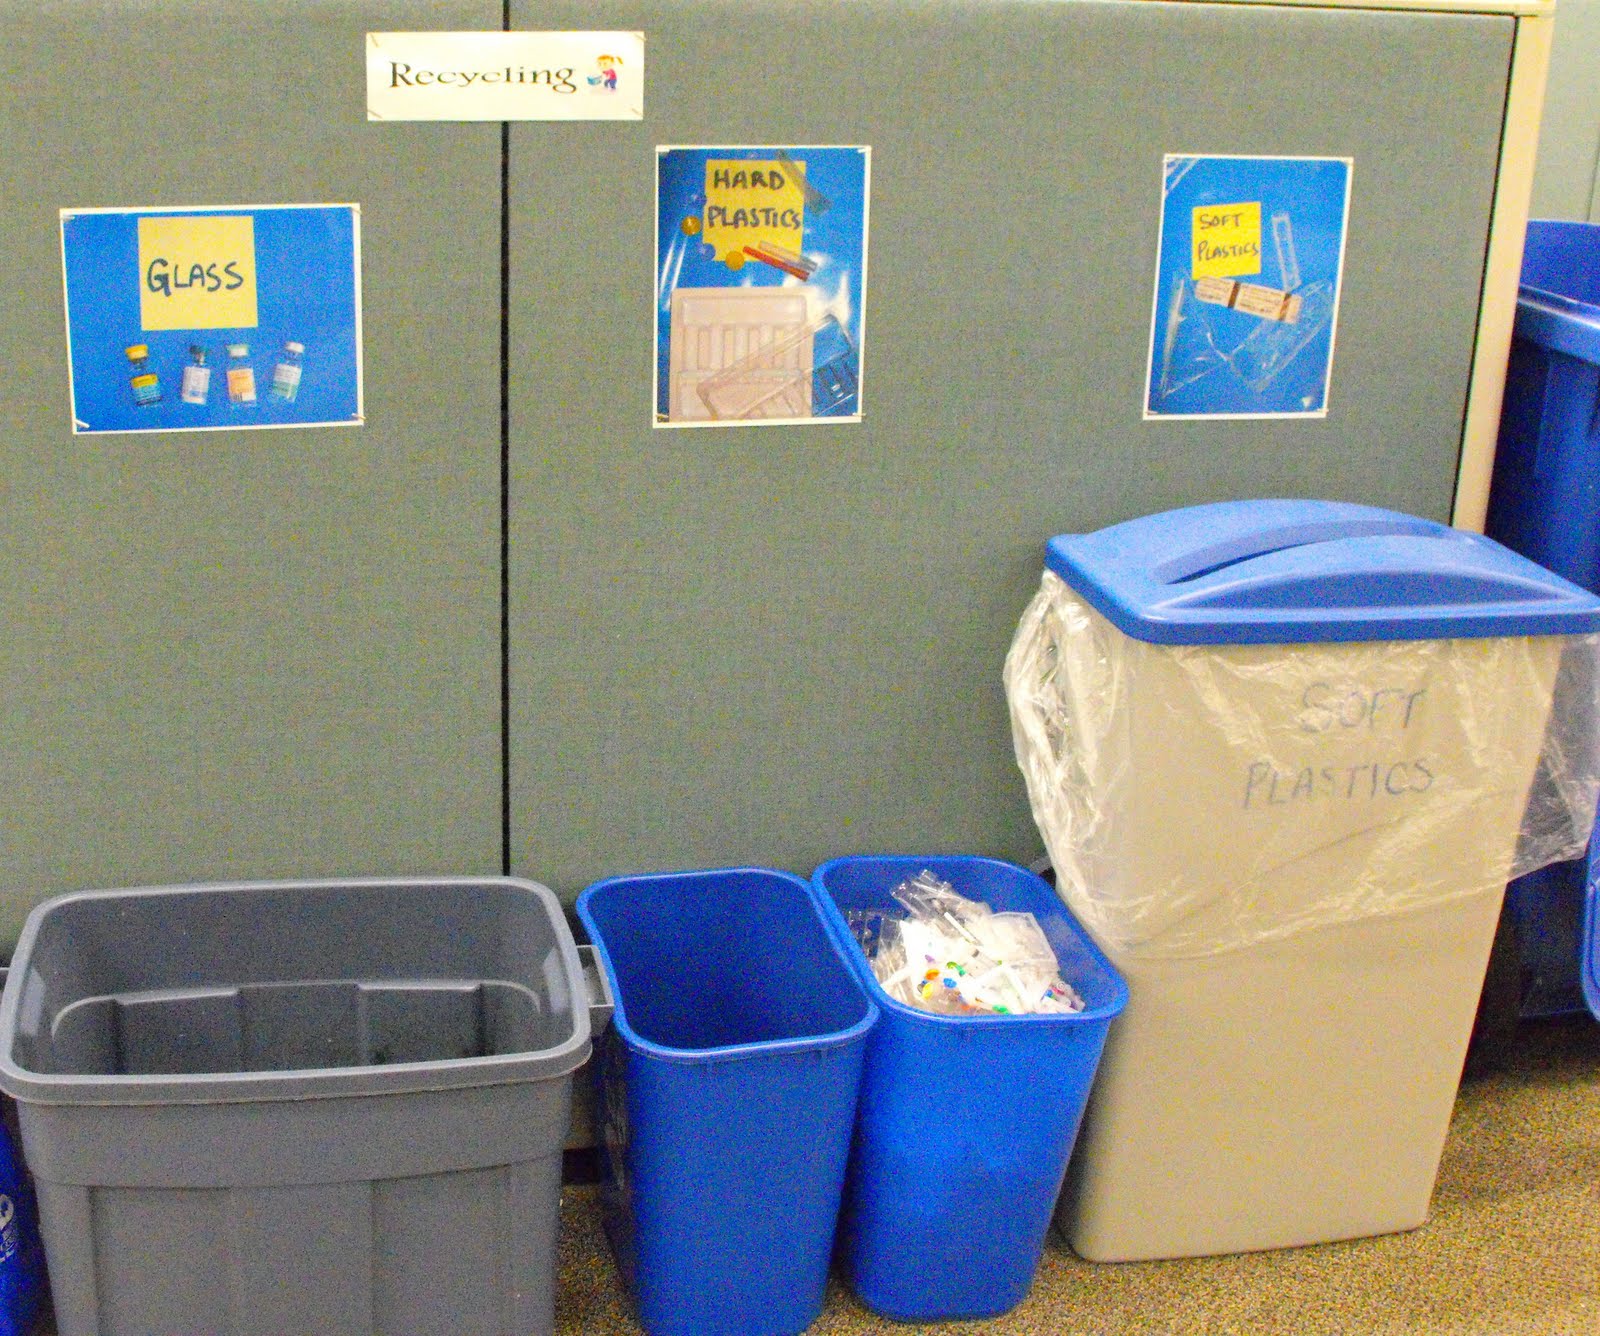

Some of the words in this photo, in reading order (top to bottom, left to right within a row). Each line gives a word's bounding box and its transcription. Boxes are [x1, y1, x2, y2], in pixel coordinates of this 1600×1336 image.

[389, 61, 577, 94] Recycling
[713, 168, 785, 191] HARD
[707, 205, 802, 230] PLASTICS
[1199, 212, 1245, 231] SOFT
[1197, 240, 1260, 262] PLASTICS
[146, 257, 245, 297] GLASS
[1244, 757, 1434, 810] PLASTICS
